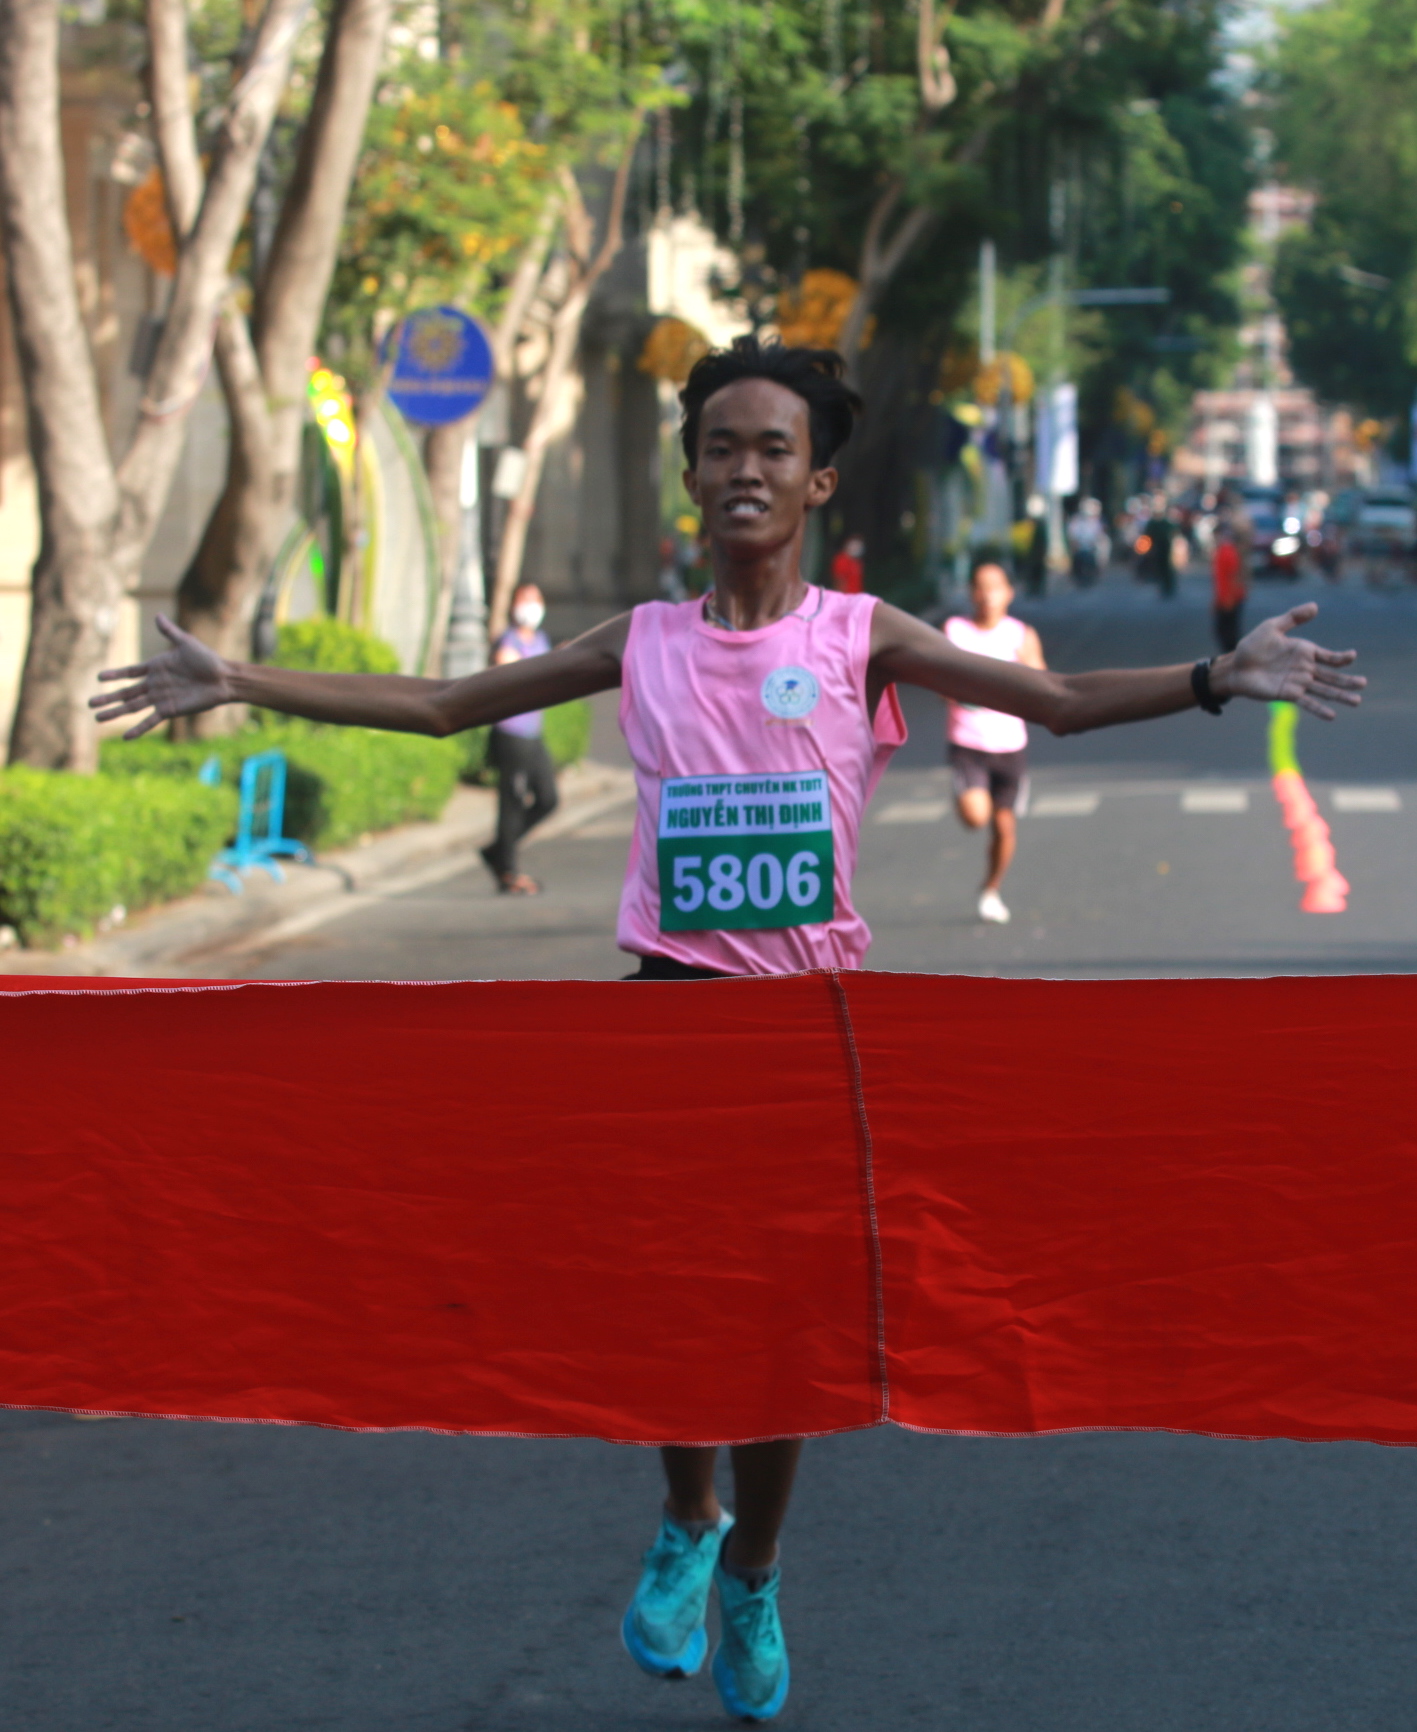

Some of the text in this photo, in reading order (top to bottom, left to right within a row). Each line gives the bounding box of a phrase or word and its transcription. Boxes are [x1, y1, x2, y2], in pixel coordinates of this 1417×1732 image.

[706, 782, 732, 796] THPT
[735, 779, 779, 795] CHUYÊN
[743, 803, 774, 829] THỊ
[779, 801, 822, 829] ĐỊNH
[673, 851, 821, 912] 5806
